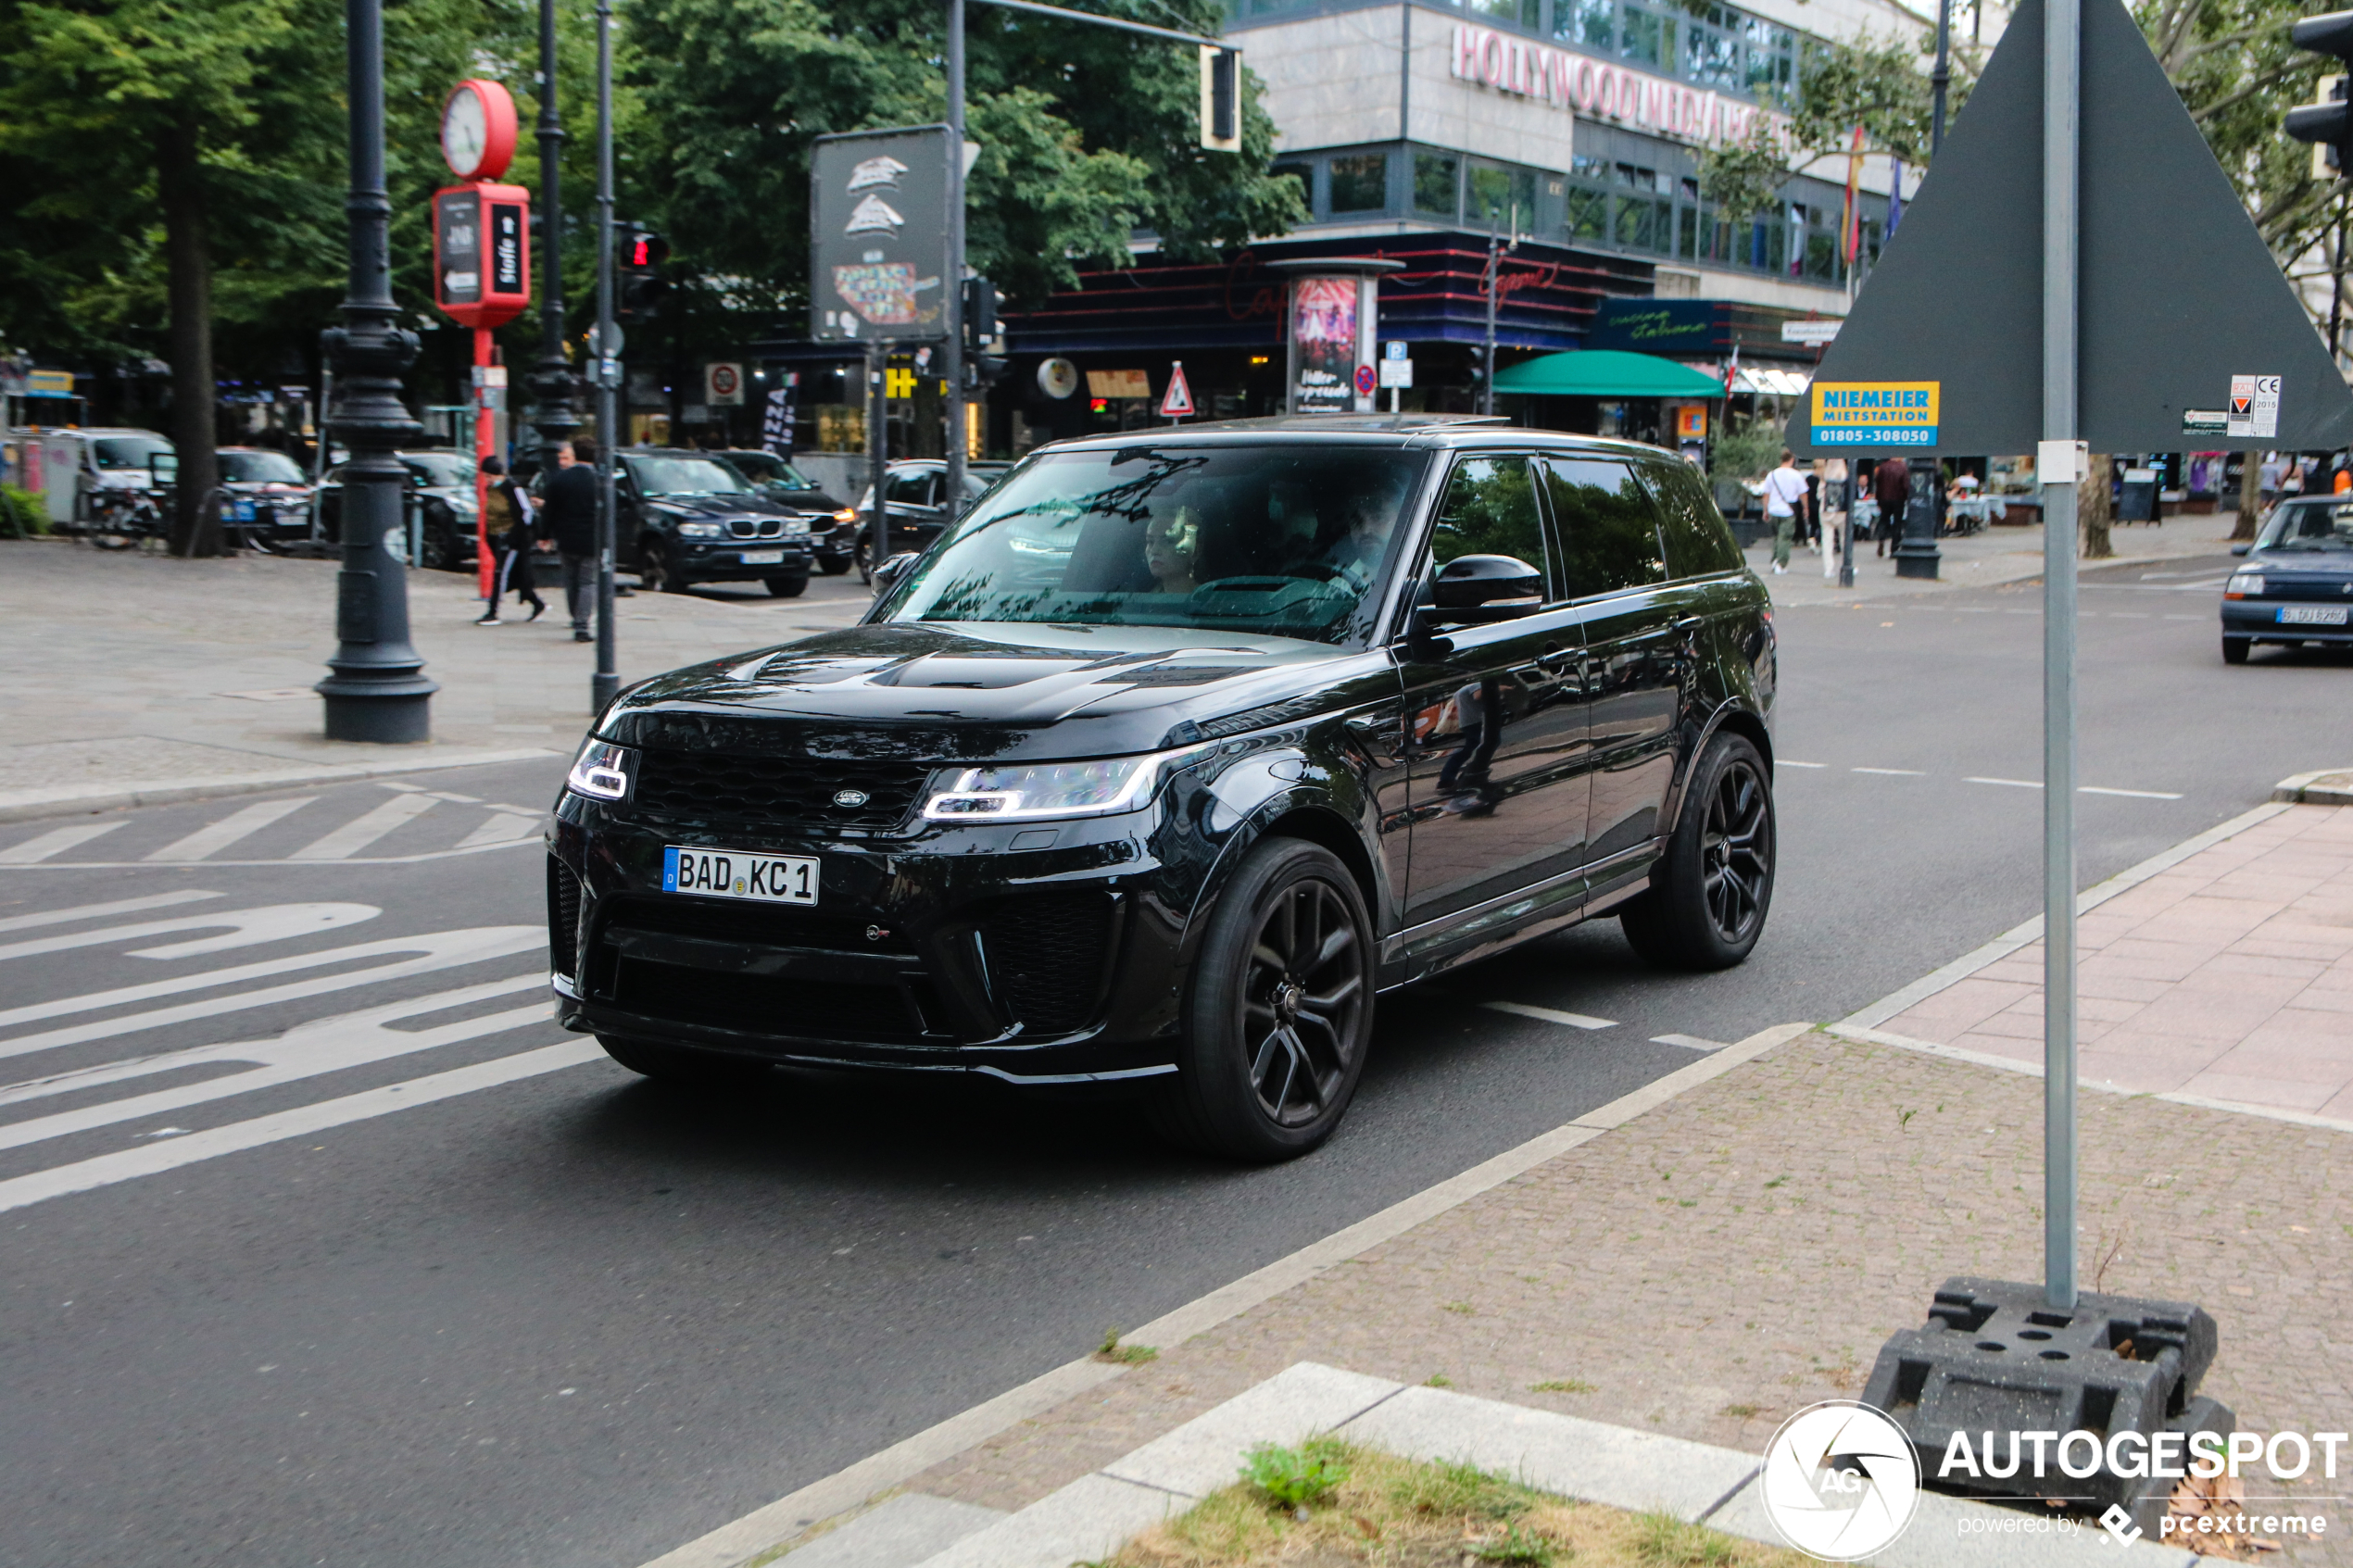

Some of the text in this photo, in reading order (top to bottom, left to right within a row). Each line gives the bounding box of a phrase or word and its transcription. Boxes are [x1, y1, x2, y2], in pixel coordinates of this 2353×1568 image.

[1454, 25, 1637, 119] HOLLYWOOD
[1646, 79, 1720, 144] MEDIA
[1823, 390, 1930, 408] NIEMEIER
[1822, 411, 1928, 421] MIETSTATION
[667, 873, 673, 884] D
[678, 853, 812, 898] BAD KC 1
